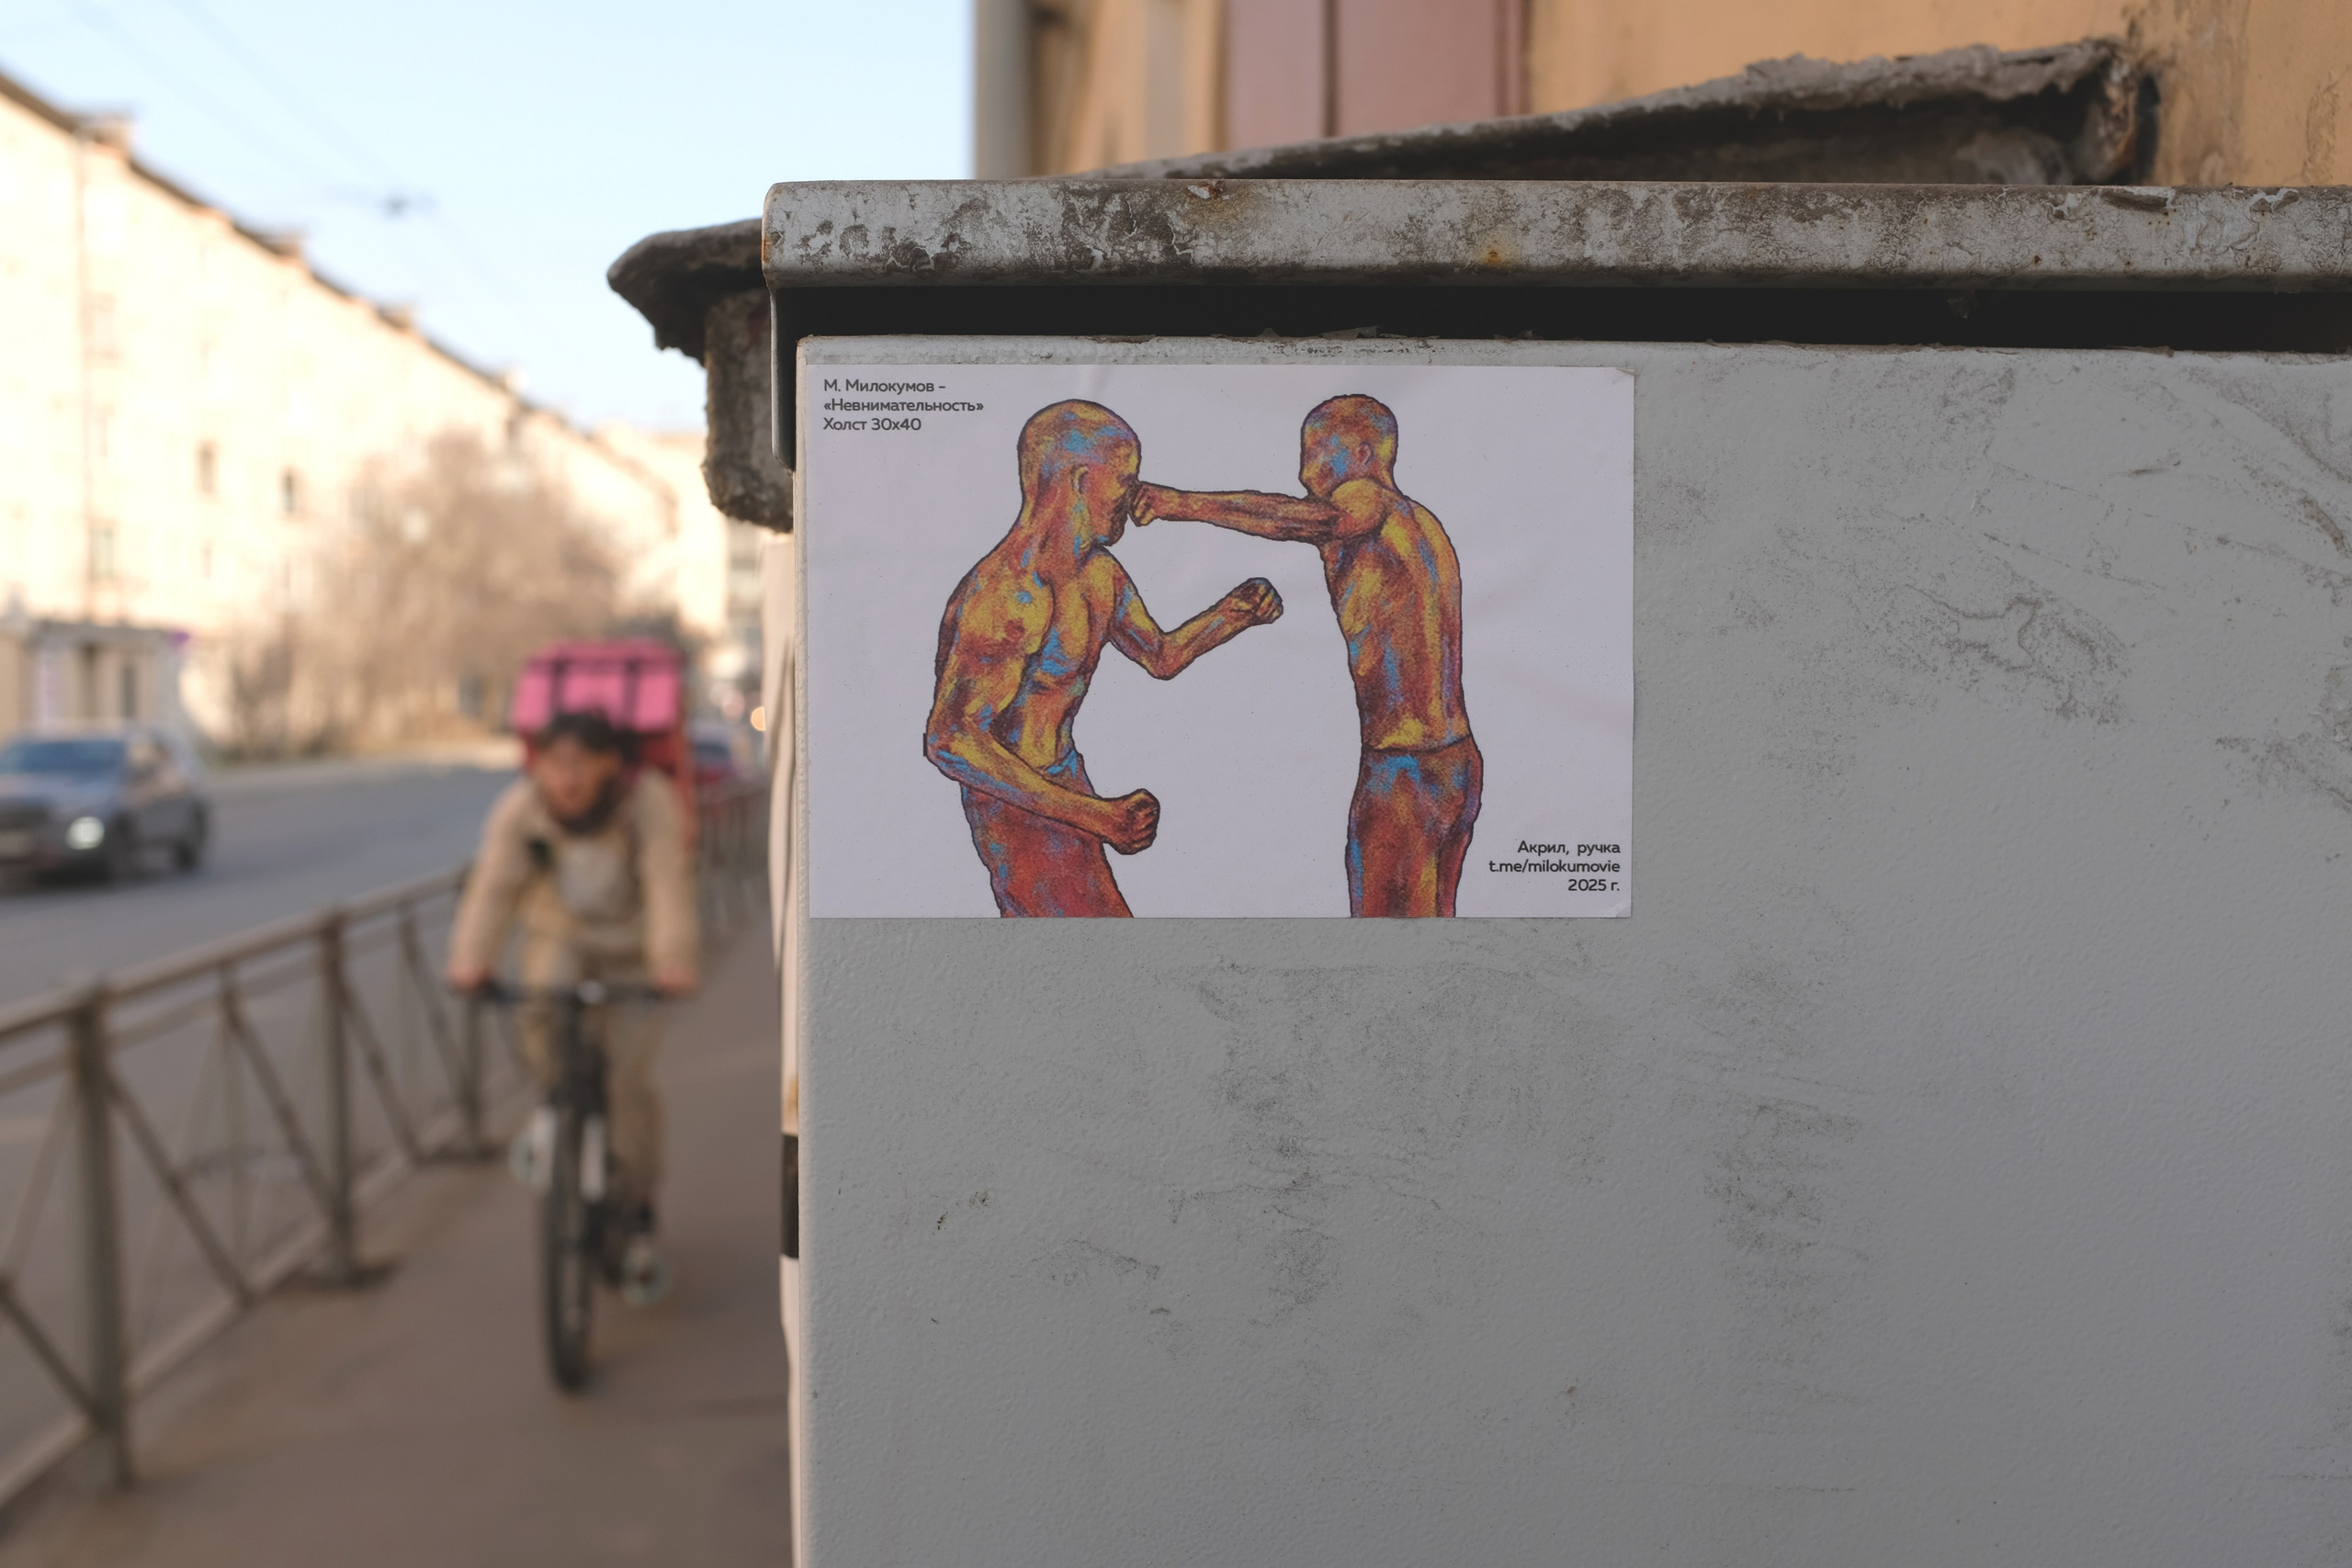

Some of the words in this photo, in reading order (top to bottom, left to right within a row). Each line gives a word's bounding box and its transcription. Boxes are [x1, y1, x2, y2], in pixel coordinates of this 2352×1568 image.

[823, 378, 842, 392] М.
[845, 378, 935, 396] Милокумов
[823, 398, 985, 412] «Невнимательность»
[822, 417, 868, 431] Холст
[1517, 840, 1570, 857] Акрил,
[1577, 843, 1622, 857] ручка
[1487, 858, 1621, 874] t.me/milokumovie
[1567, 878, 1608, 892] 2025
[1610, 881, 1621, 892] г.
